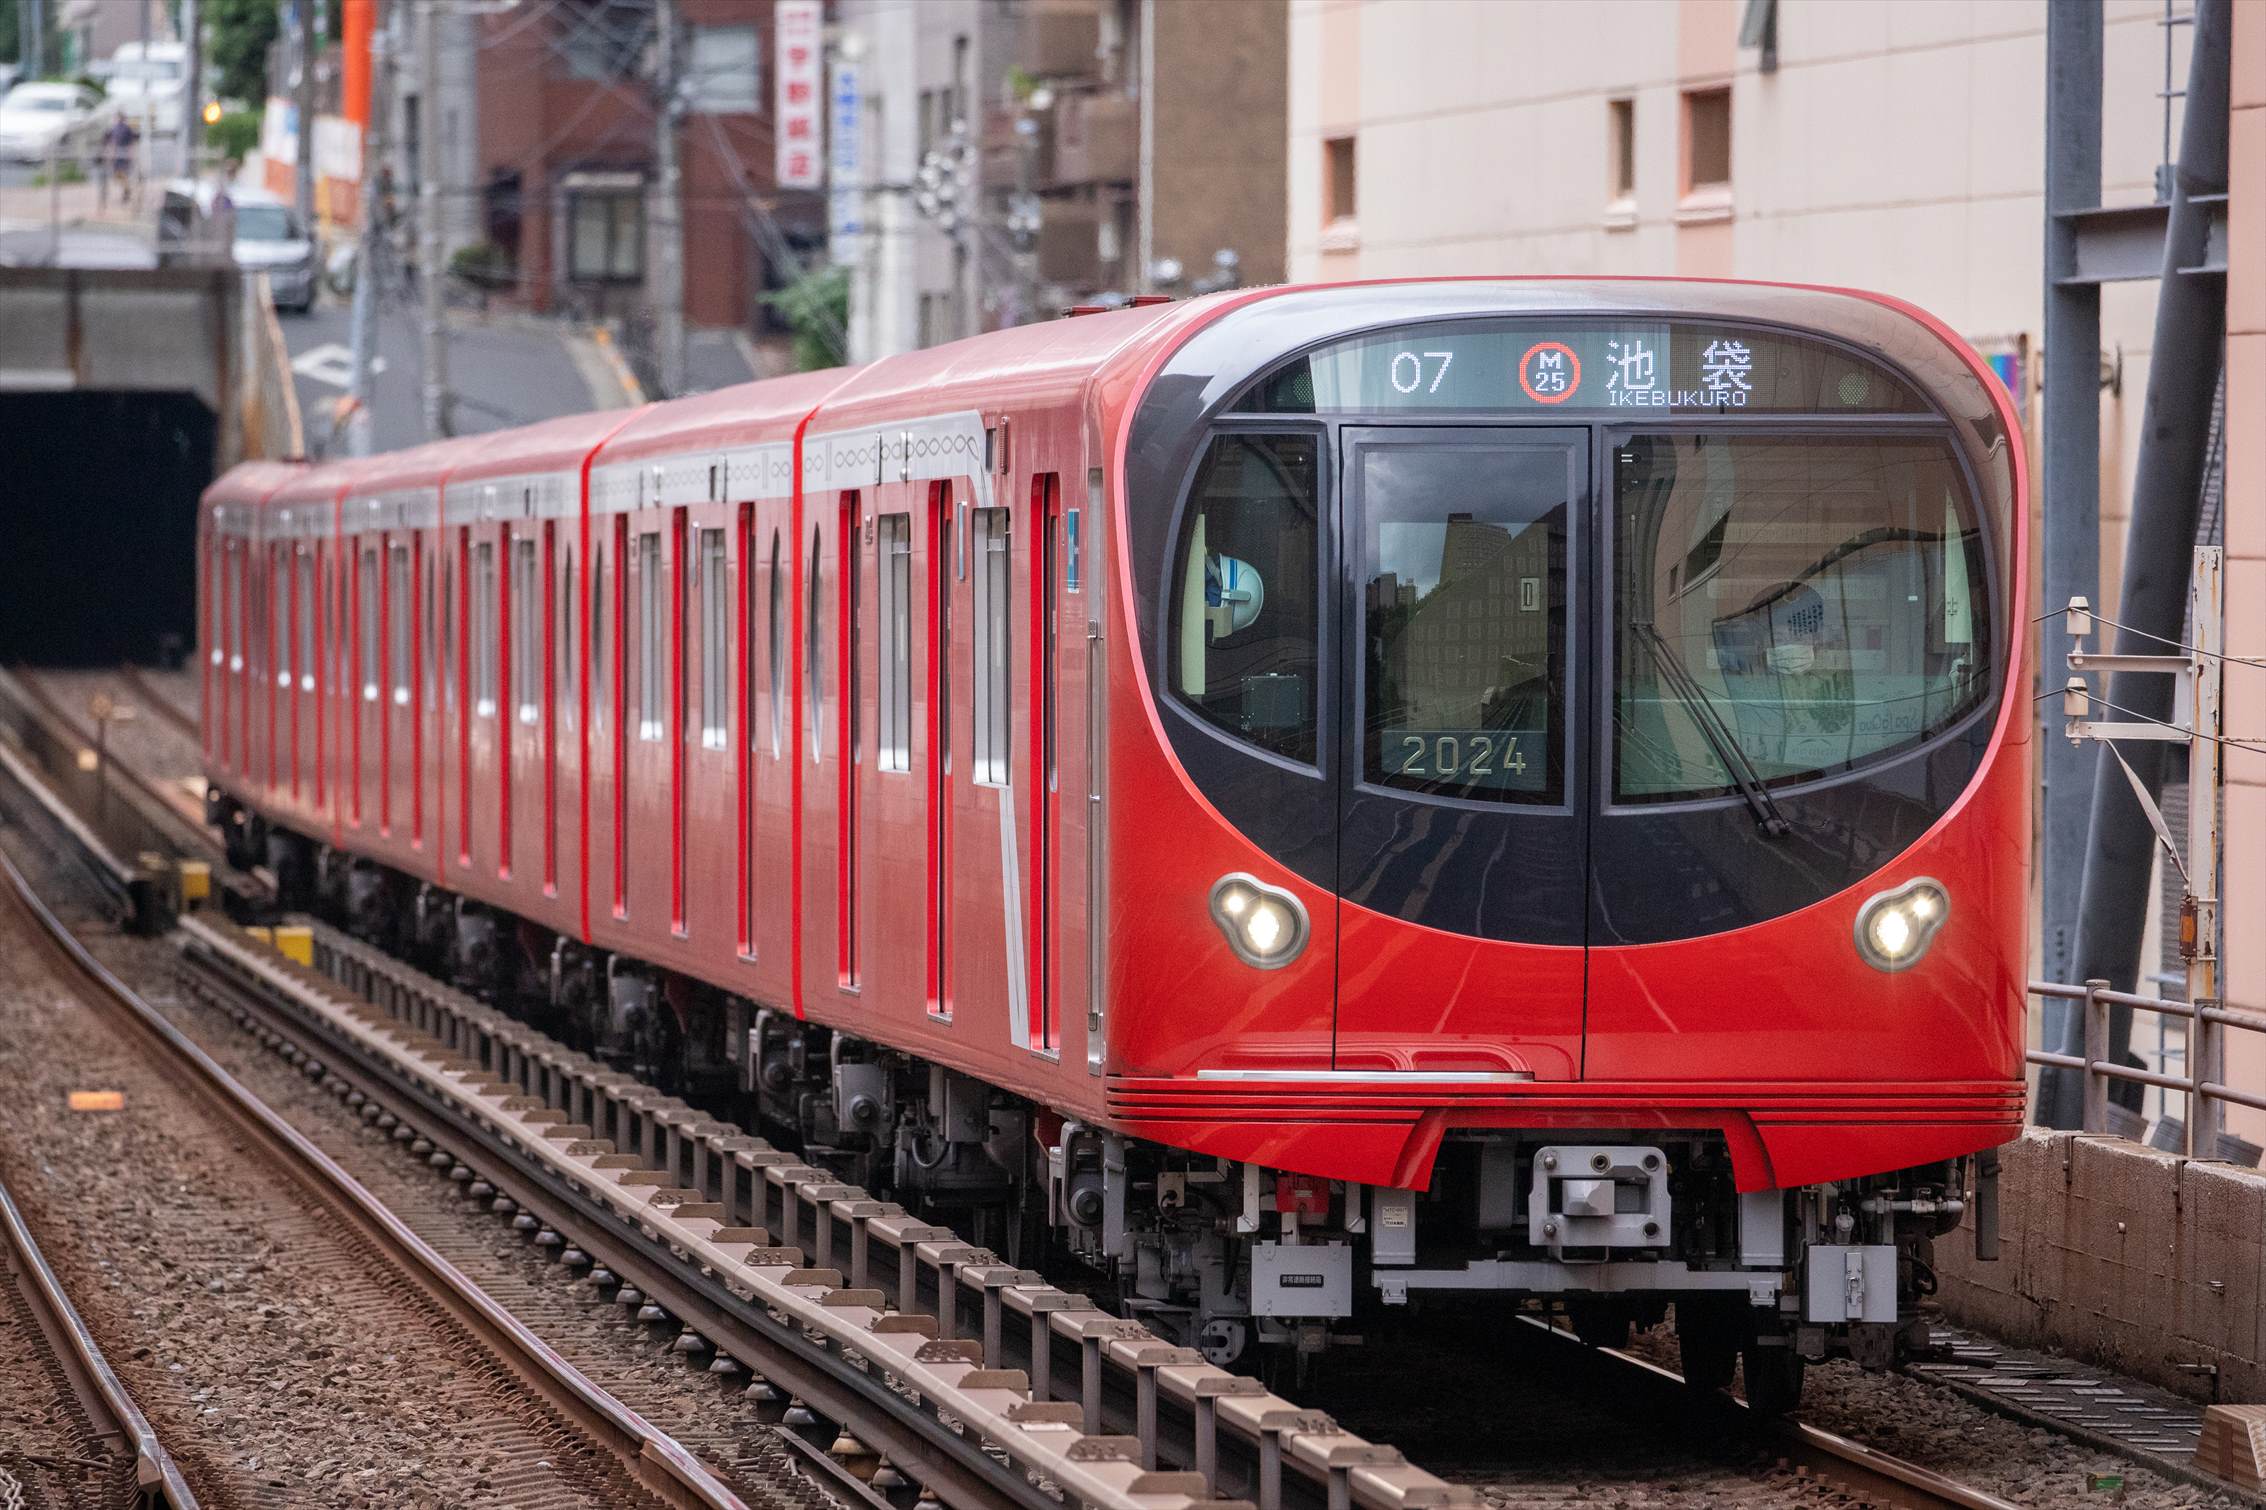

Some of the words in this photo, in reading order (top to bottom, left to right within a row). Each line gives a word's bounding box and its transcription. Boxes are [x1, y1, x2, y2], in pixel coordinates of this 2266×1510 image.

[1391, 352, 1453, 393] 07
[1539, 352, 1561, 369] M
[1606, 340, 1752, 390] 池袋
[1535, 372, 1565, 391] 25
[1609, 391, 1746, 406] IKEBUKURO
[1402, 736, 1526, 775] 2024
